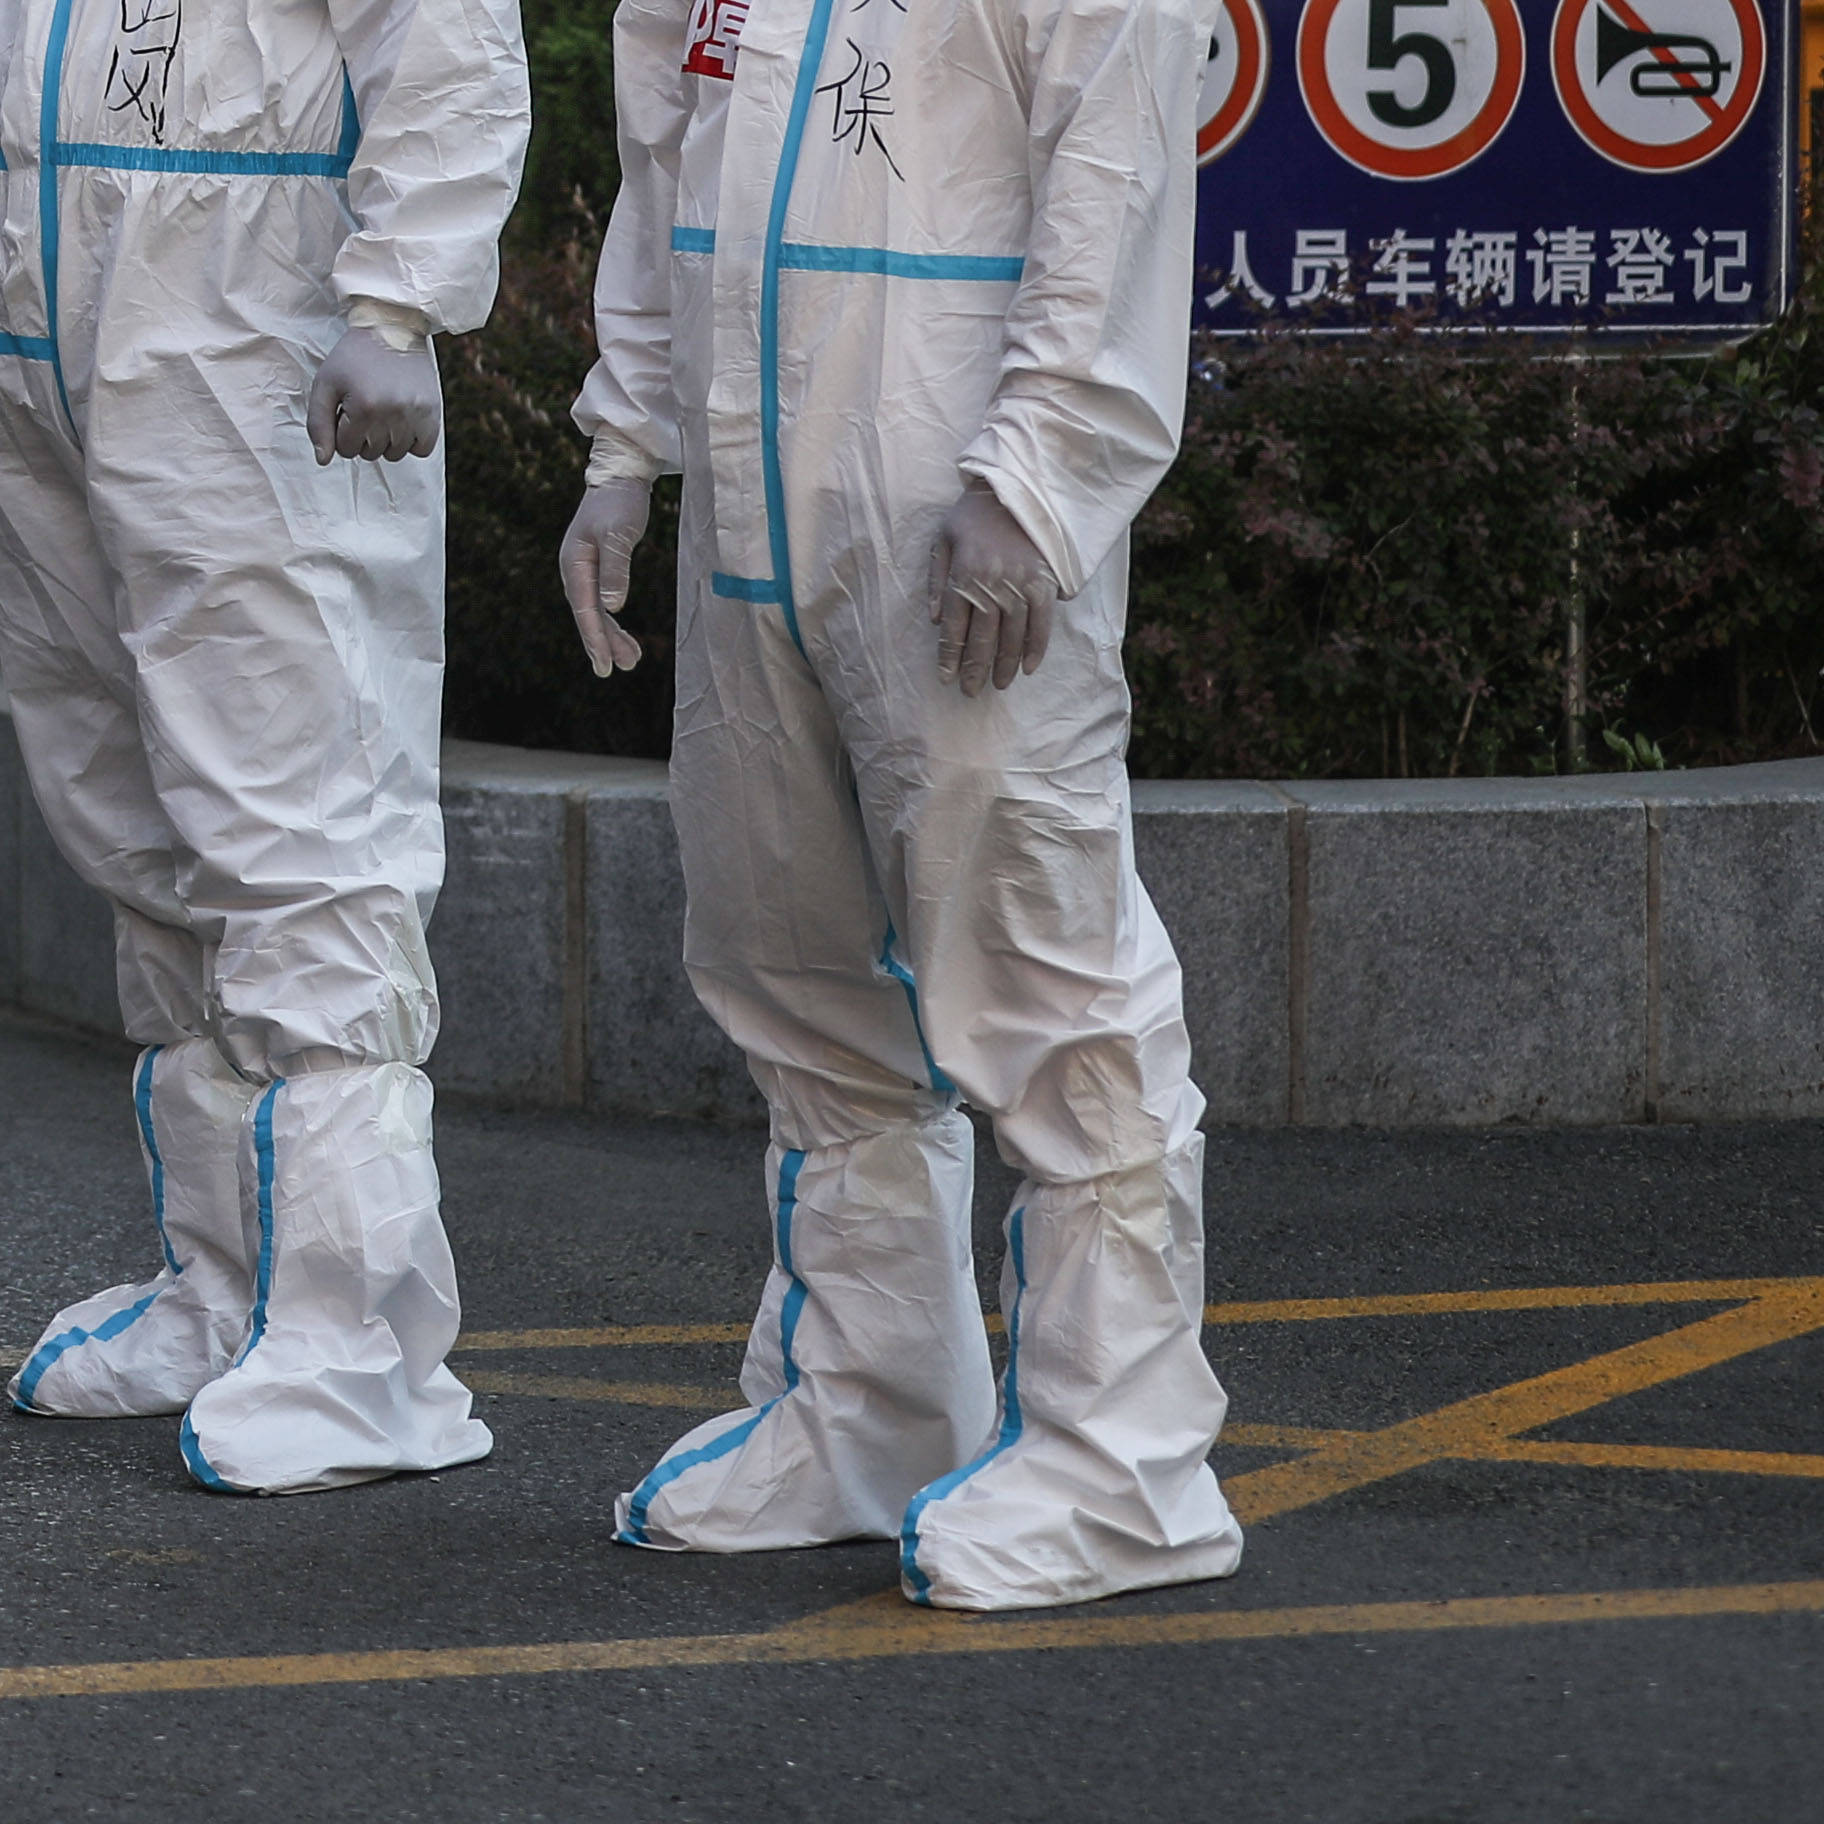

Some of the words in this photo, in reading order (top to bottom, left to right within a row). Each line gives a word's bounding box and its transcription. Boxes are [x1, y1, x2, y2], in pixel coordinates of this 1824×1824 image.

[1204, 226, 1753, 310] 人员车辆请登记
